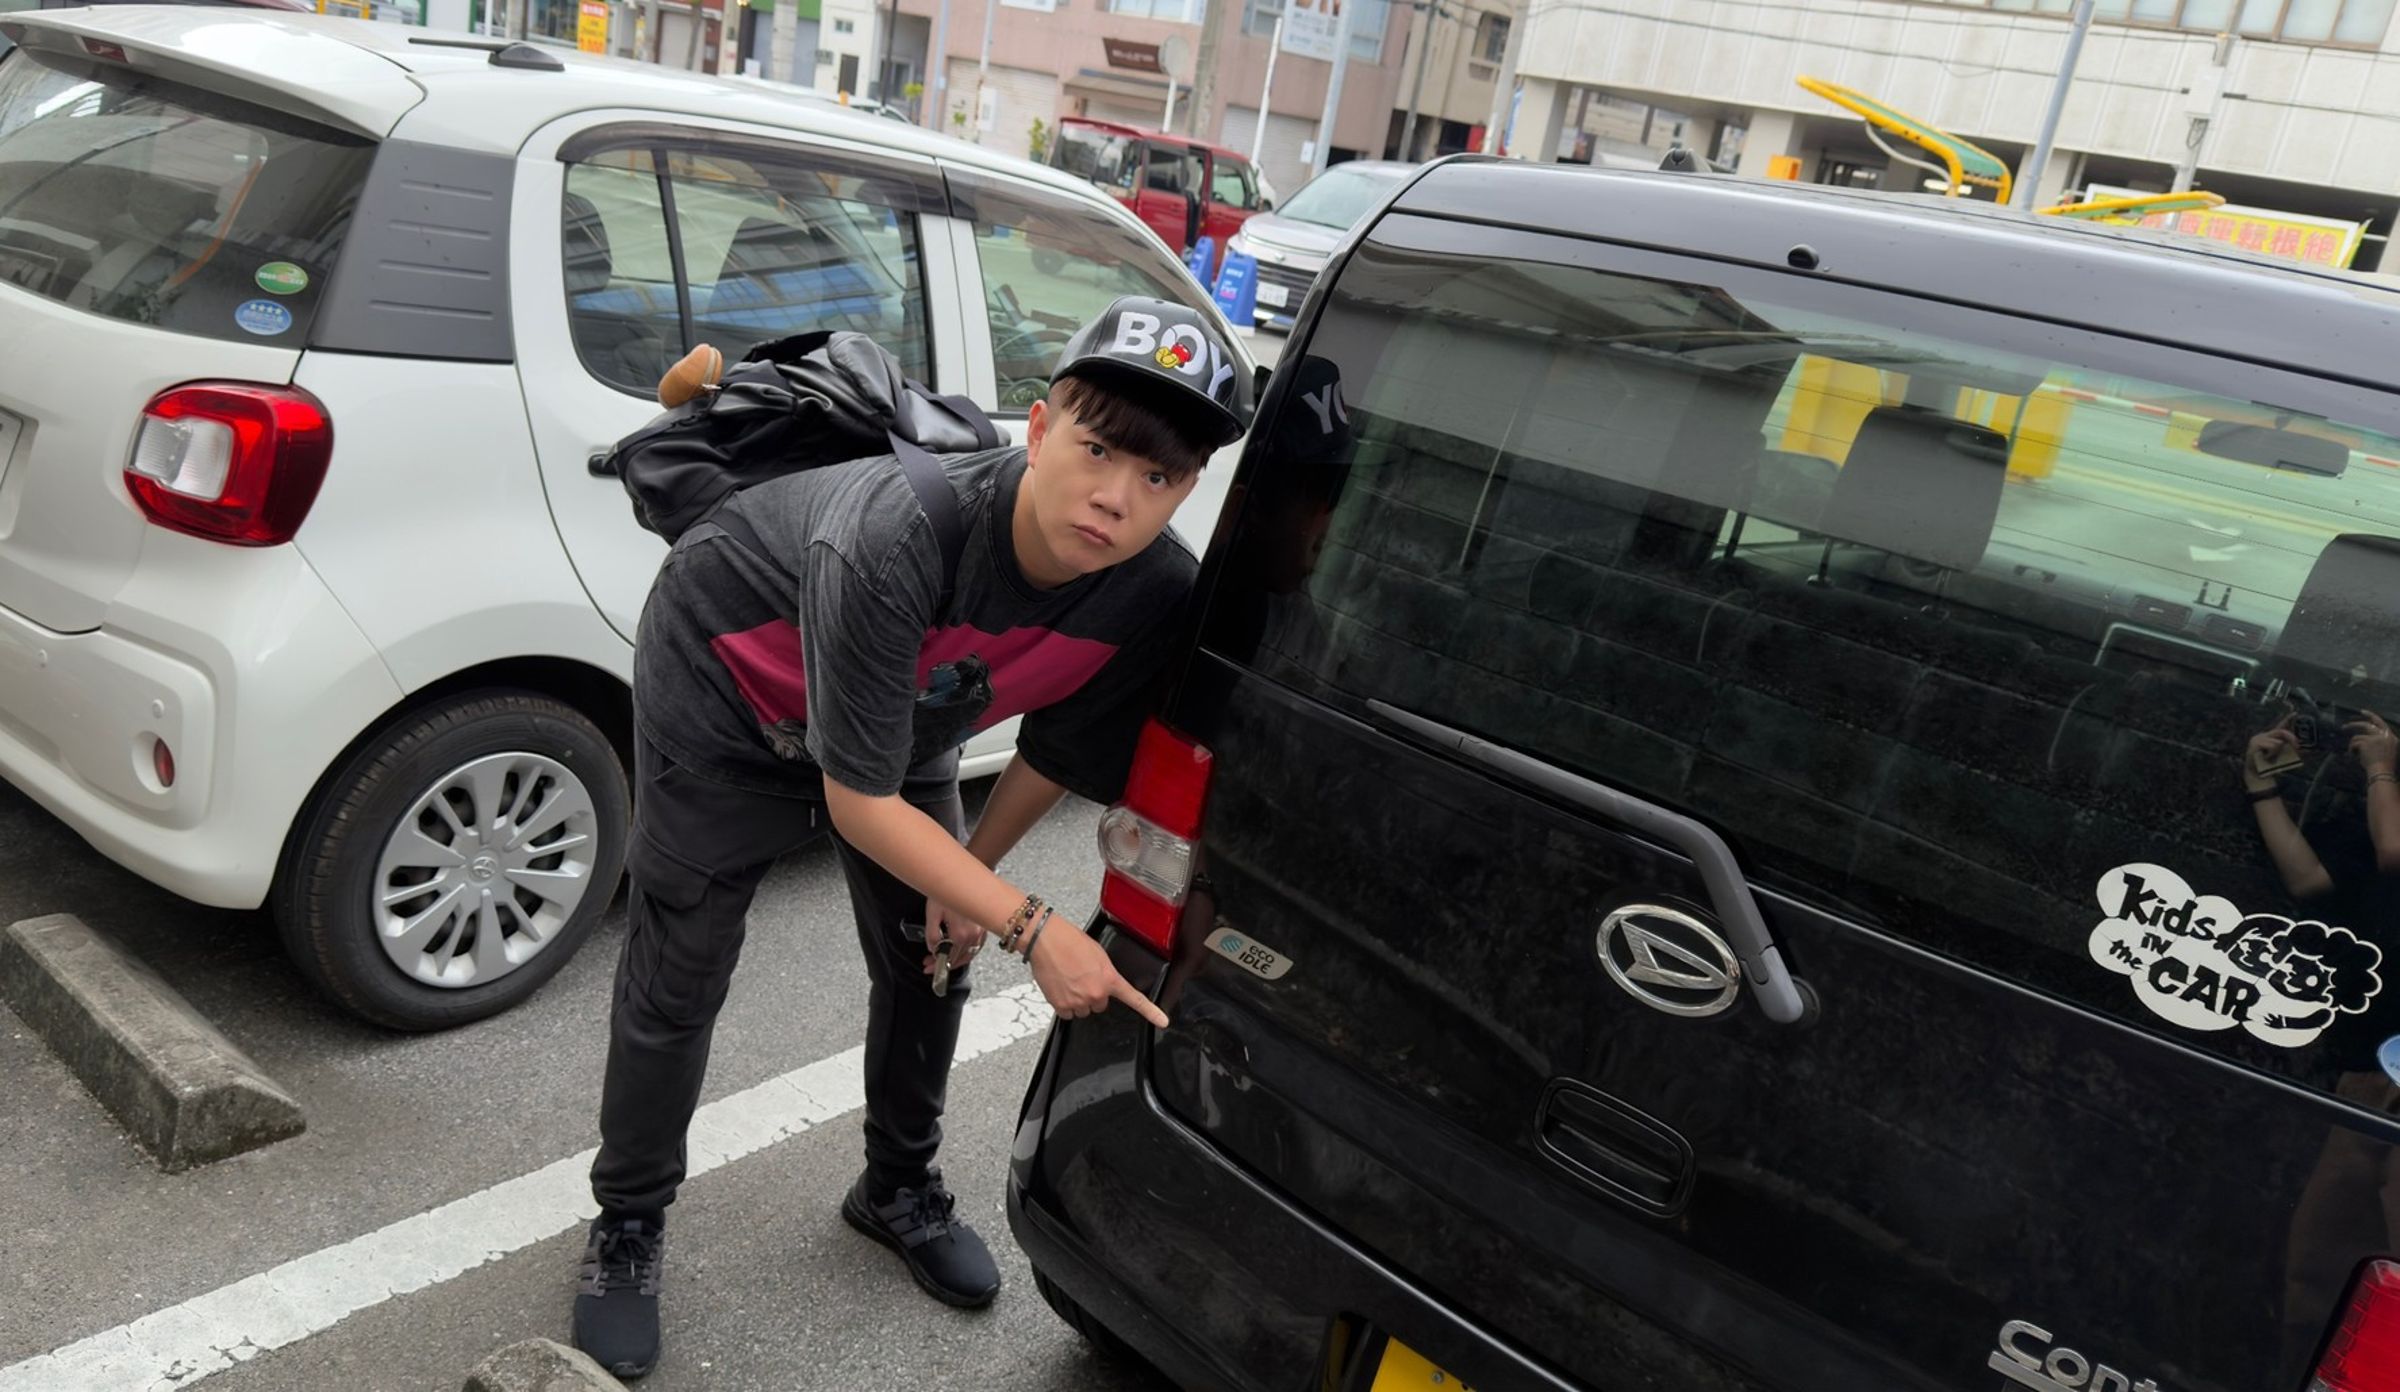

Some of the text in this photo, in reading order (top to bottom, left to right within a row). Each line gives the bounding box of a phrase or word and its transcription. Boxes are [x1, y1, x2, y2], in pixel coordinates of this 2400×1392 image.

[1110, 311, 1234, 401] BOY
[2119, 873, 2217, 941] Kids
[1238, 951, 1272, 974] IDLE
[2109, 939, 2144, 970] the
[2148, 956, 2261, 1022] CAR
